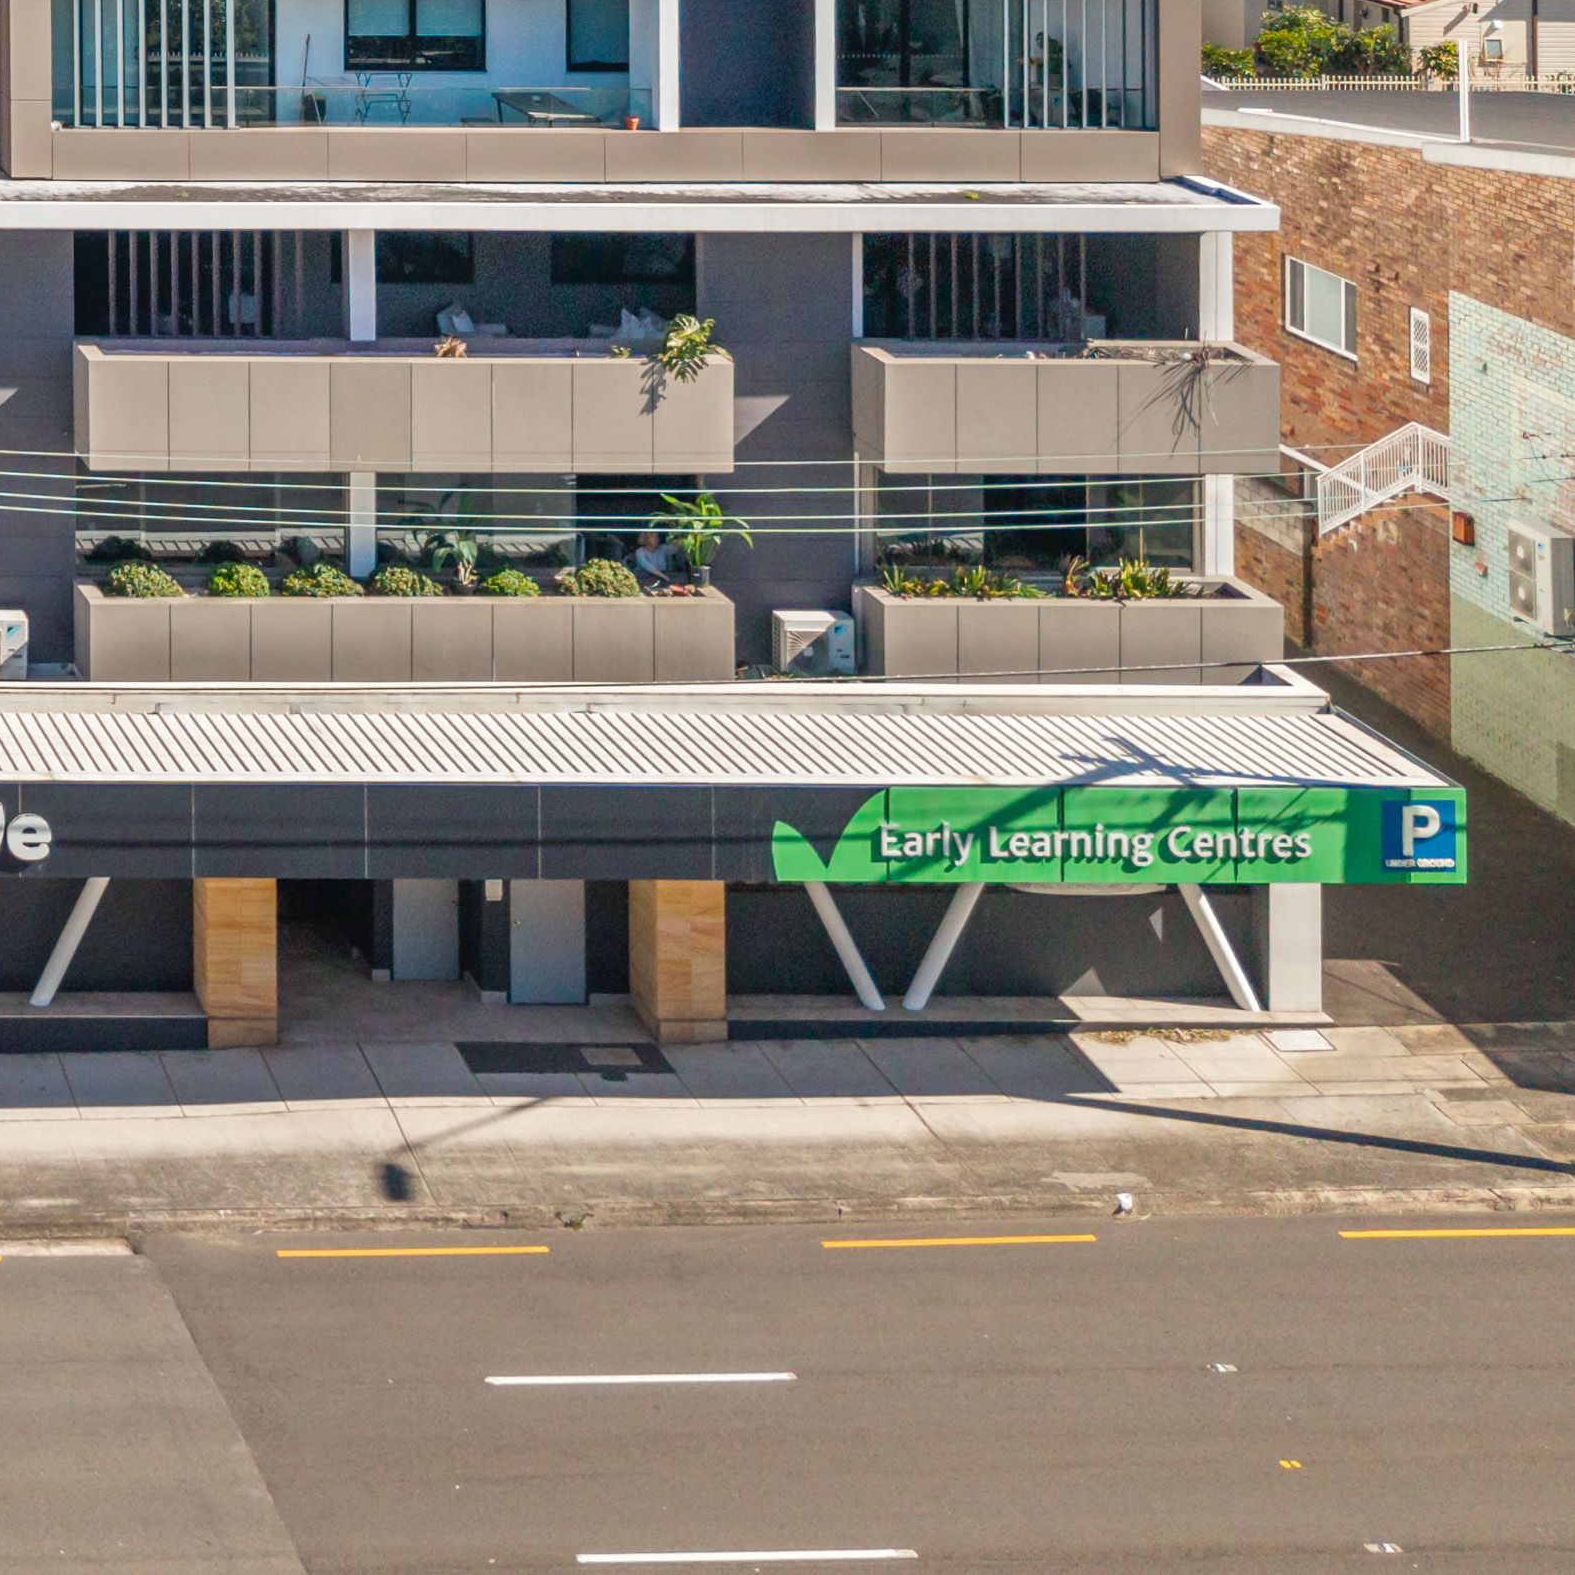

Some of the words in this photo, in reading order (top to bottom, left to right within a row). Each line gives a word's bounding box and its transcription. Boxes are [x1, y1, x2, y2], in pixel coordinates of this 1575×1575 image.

[880, 820, 974, 867] Early
[989, 823, 1154, 867] Learning
[1167, 826, 1312, 858] Centres
[1402, 805, 1441, 857] P
